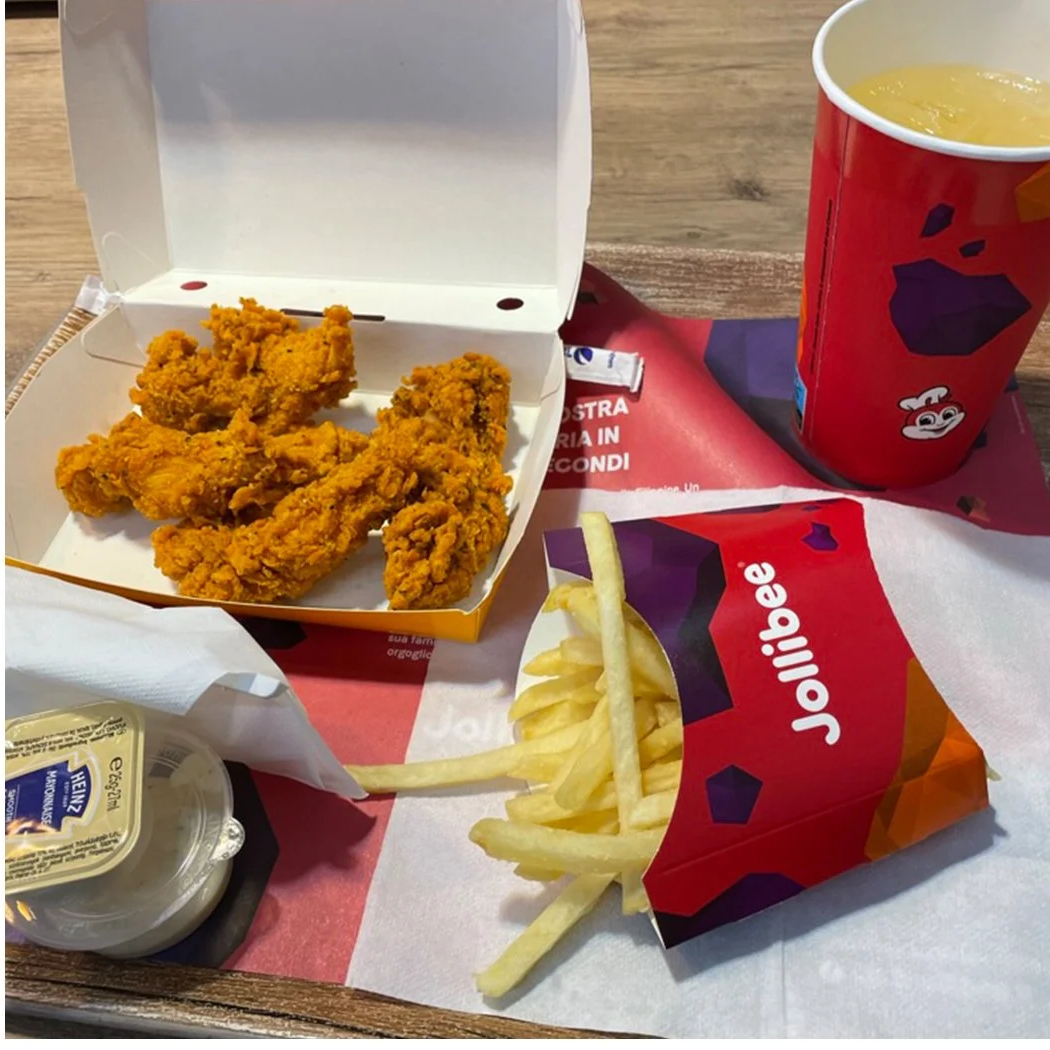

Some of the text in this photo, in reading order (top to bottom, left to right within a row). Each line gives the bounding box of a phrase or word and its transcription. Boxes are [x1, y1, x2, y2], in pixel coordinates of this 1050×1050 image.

[597, 425, 620, 446] IN
[743, 561, 841, 745] Jollibee
[41, 770, 58, 825] MAYONNAISE
[67, 771, 86, 813] HEINZ
